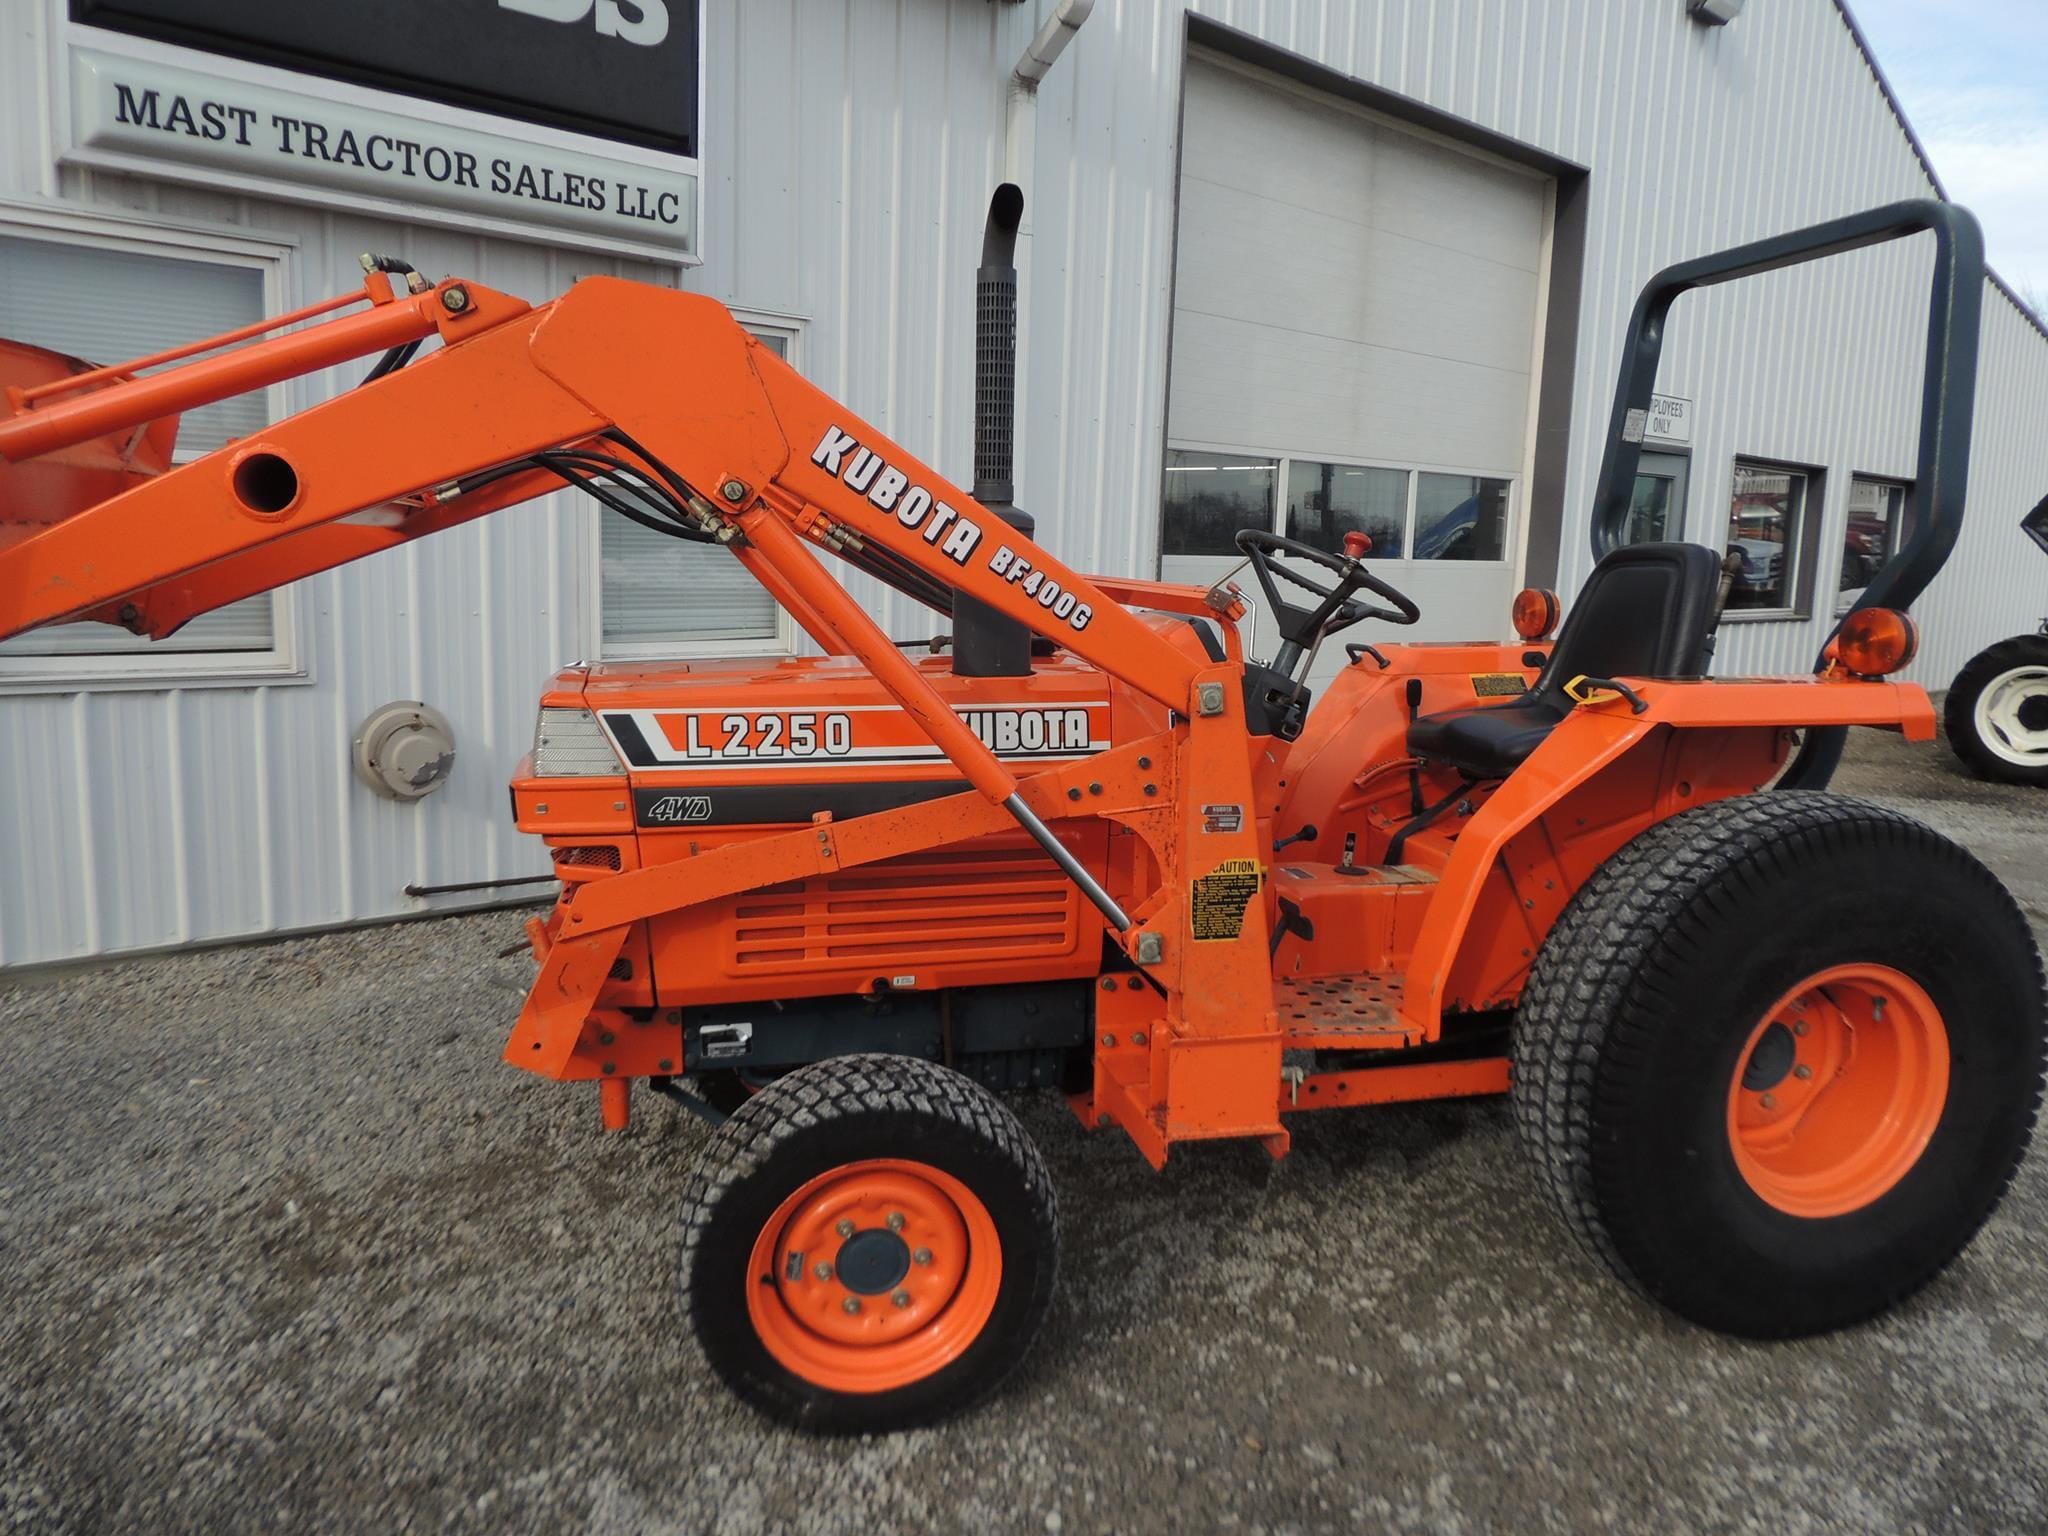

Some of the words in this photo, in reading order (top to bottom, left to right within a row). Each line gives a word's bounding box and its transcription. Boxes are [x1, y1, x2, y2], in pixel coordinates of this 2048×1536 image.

[115, 83, 257, 146] MAST
[272, 116, 480, 189] TRACTOR
[491, 159, 607, 212] SALES
[616, 181, 680, 225] LLC
[1653, 416, 1671, 433] ONLY
[811, 424, 983, 567] KUBOTA
[988, 544, 1093, 632] BF400G
[957, 709, 1090, 751] UBOTA
[648, 796, 712, 821] 4WD
